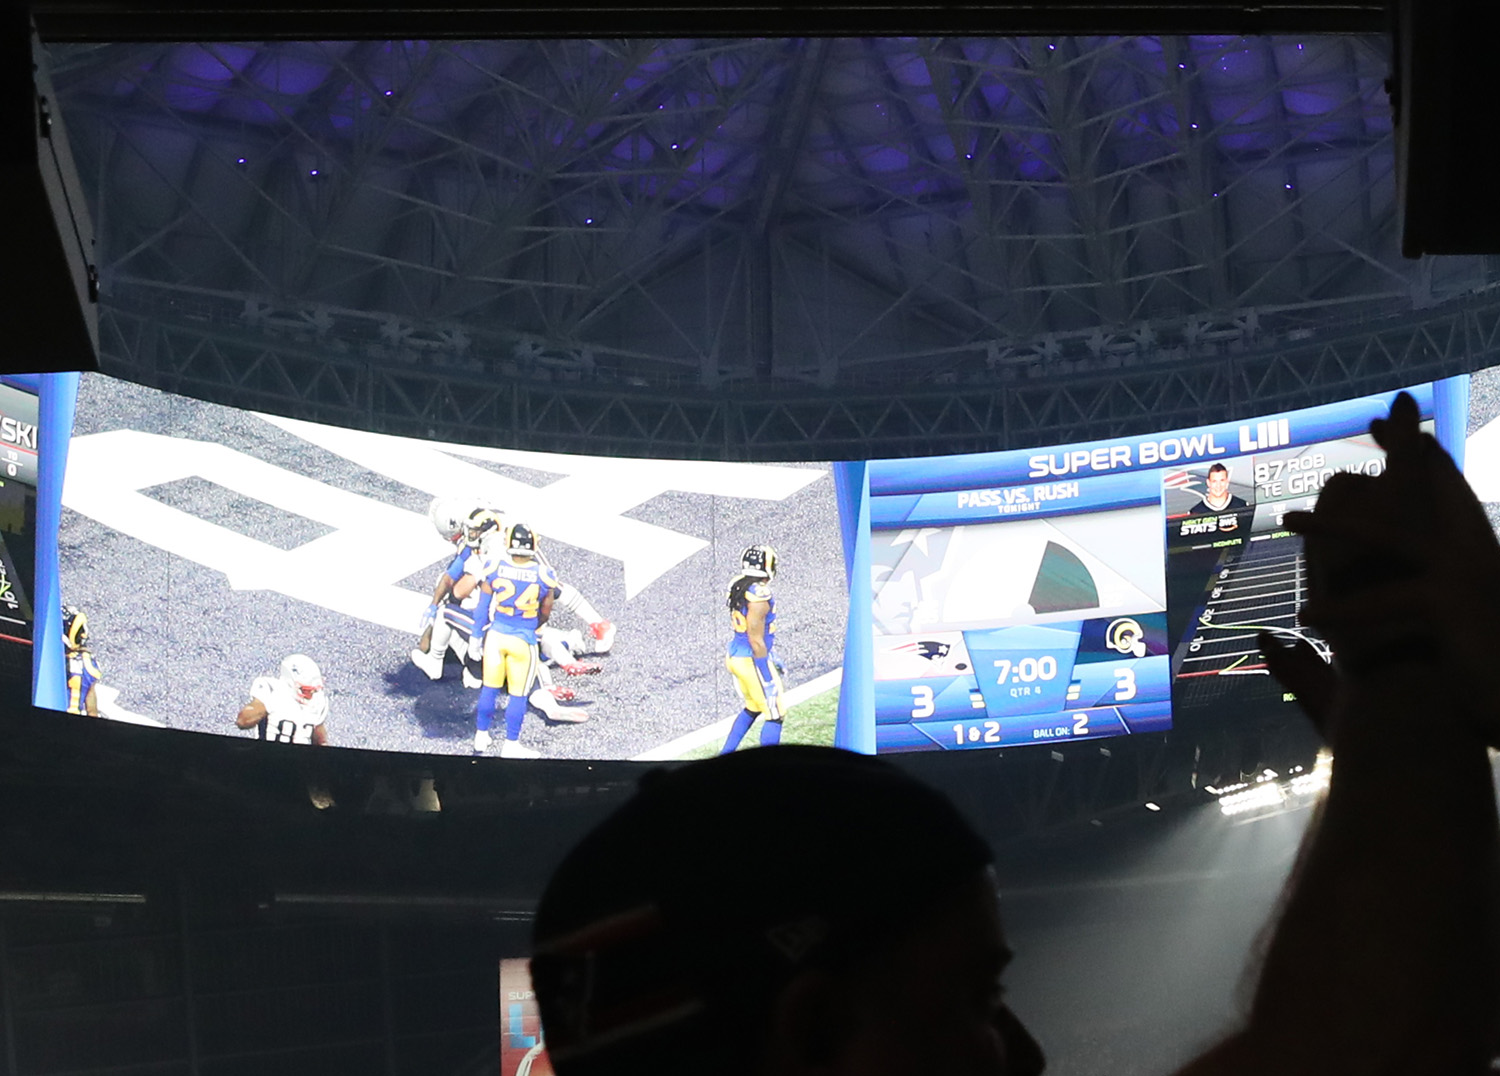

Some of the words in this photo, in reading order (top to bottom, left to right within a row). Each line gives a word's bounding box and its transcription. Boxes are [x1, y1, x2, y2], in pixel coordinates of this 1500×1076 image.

[0, 416, 38, 450] SKI
[1028, 446, 1132, 478] SUPER
[1138, 433, 1225, 466] BOWL
[1238, 419, 1290, 452] LIII
[8, 462, 17, 477] 0
[1255, 461, 1284, 484] 87
[1286, 452, 1326, 474] ROB
[957, 489, 1002, 509] PASS
[1003, 486, 1031, 505] VS.
[1033, 481, 1080, 502] RUSH
[1261, 484, 1283, 499] TE
[997, 501, 1041, 514] TONIGHT
[1179, 522, 1218, 537] STATS
[1218, 517, 1238, 528] aws
[490, 577, 541, 619] 24
[993, 655, 1057, 685] 7:00
[1009, 687, 1032, 699] QTR
[1113, 667, 1138, 701] 3
[910, 684, 935, 719] 3
[1033, 729, 1053, 739] BALL
[1072, 713, 1089, 735] 2
[508, 991, 535, 1001] SUP
